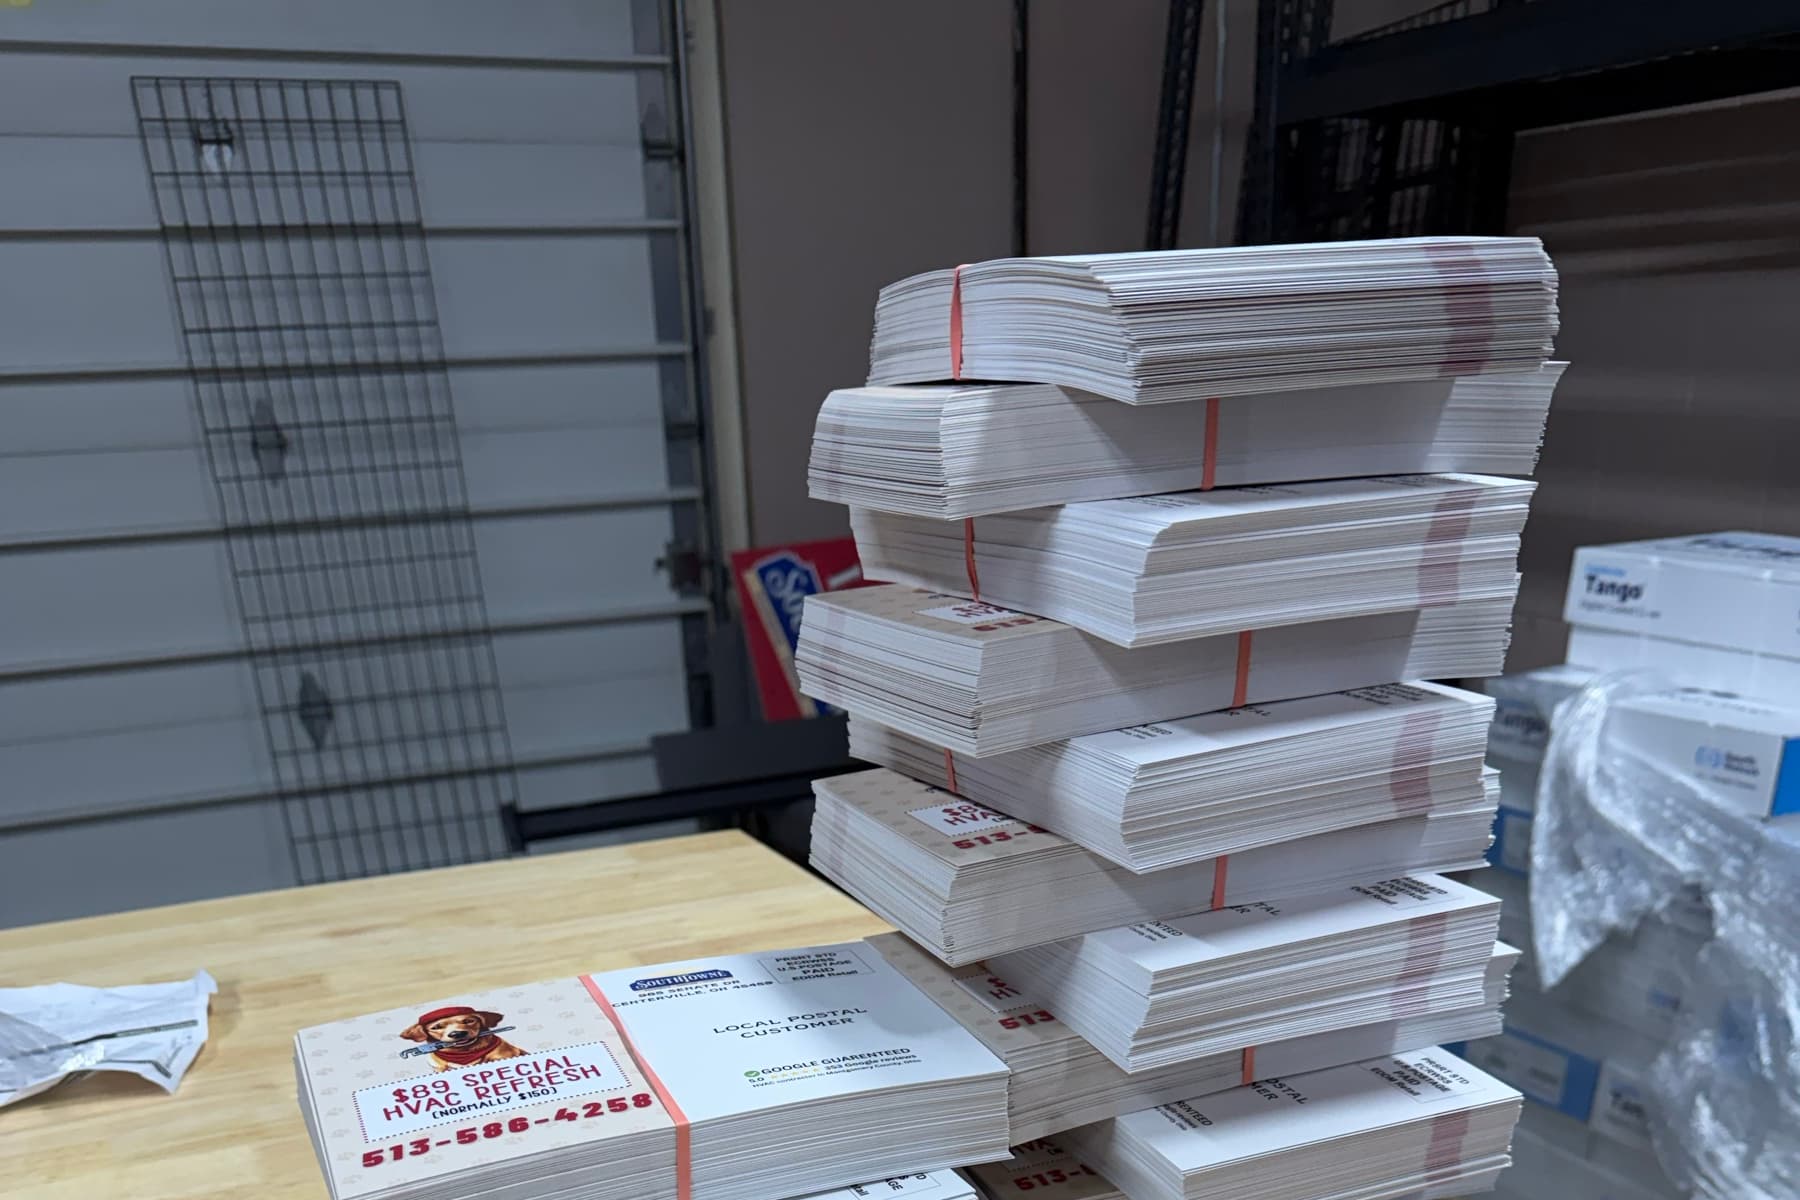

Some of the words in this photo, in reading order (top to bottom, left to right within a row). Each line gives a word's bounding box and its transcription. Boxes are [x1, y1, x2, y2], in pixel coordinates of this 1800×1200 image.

[1585, 572, 1645, 603] Tango
[801, 967, 836, 975] PAID
[668, 982, 719, 995] SENATE
[709, 986, 729, 994] OH
[712, 1018, 782, 1034] LOCAL
[787, 1006, 869, 1023] POSTAL
[740, 1016, 856, 1039] CUSTOMER
[761, 1060, 819, 1076] GOOGLE
[821, 1047, 911, 1066] GUARENTEED
[843, 1058, 880, 1070] Google
[879, 1053, 918, 1064] reviews
[391, 1078, 450, 1104] $89
[461, 1055, 582, 1088] SPECIAL
[1393, 1070, 1421, 1086] PAID
[382, 1091, 463, 1121] HVAC
[473, 1064, 603, 1101] REFRESH
[431, 1095, 512, 1120] (NORMALLY
[518, 1086, 559, 1101] $150)
[362, 1093, 653, 1168] 513-586-4258
